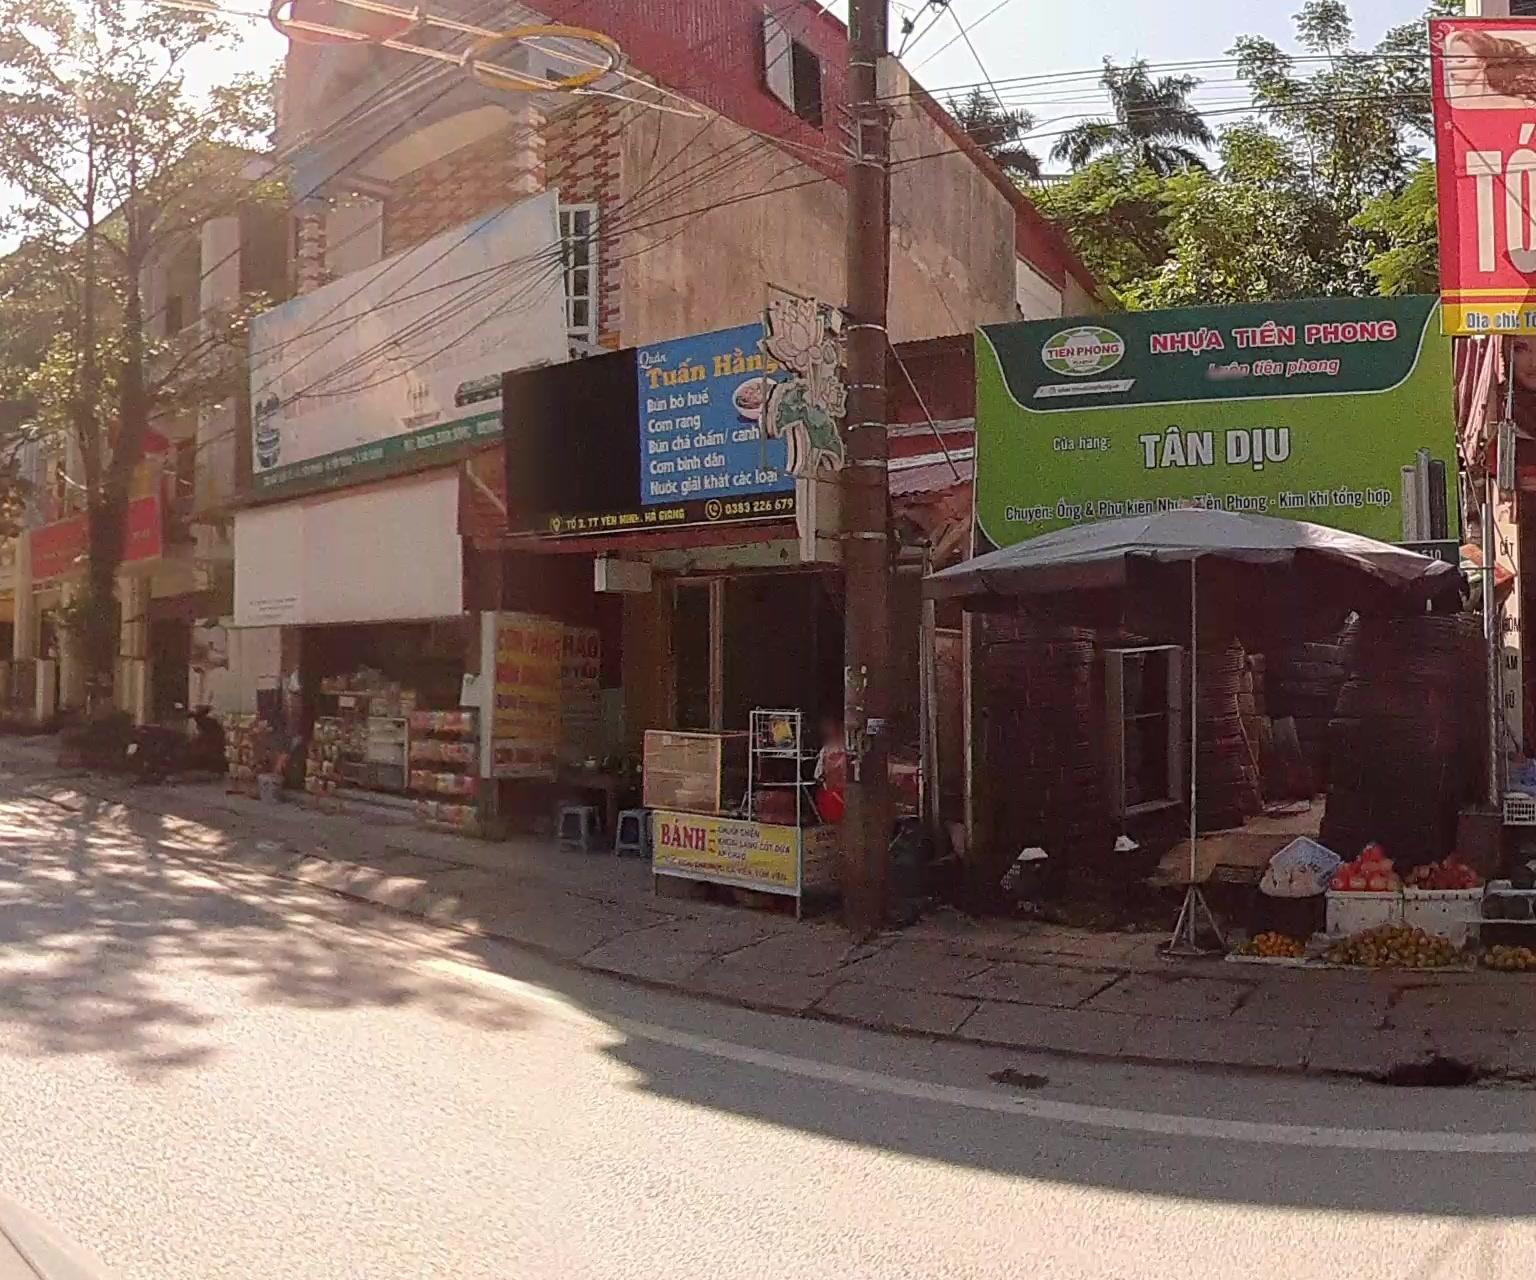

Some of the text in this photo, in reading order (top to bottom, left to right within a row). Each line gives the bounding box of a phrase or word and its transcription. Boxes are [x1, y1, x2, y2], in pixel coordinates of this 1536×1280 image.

[1150, 320, 1398, 356] NHỰA TIỀN PHONG
[1077, 344, 1120, 356] PHONG
[646, 357, 706, 390] Tuấn
[1285, 358, 1340, 377] phong
[676, 415, 701, 431] rang
[1139, 424, 1291, 472] TÂN DỊU
[725, 498, 795, 516] 0383 226 679
[1085, 502, 1095, 517] &
[1226, 493, 1268, 513] Phong
[1278, 491, 1304, 508] Kim
